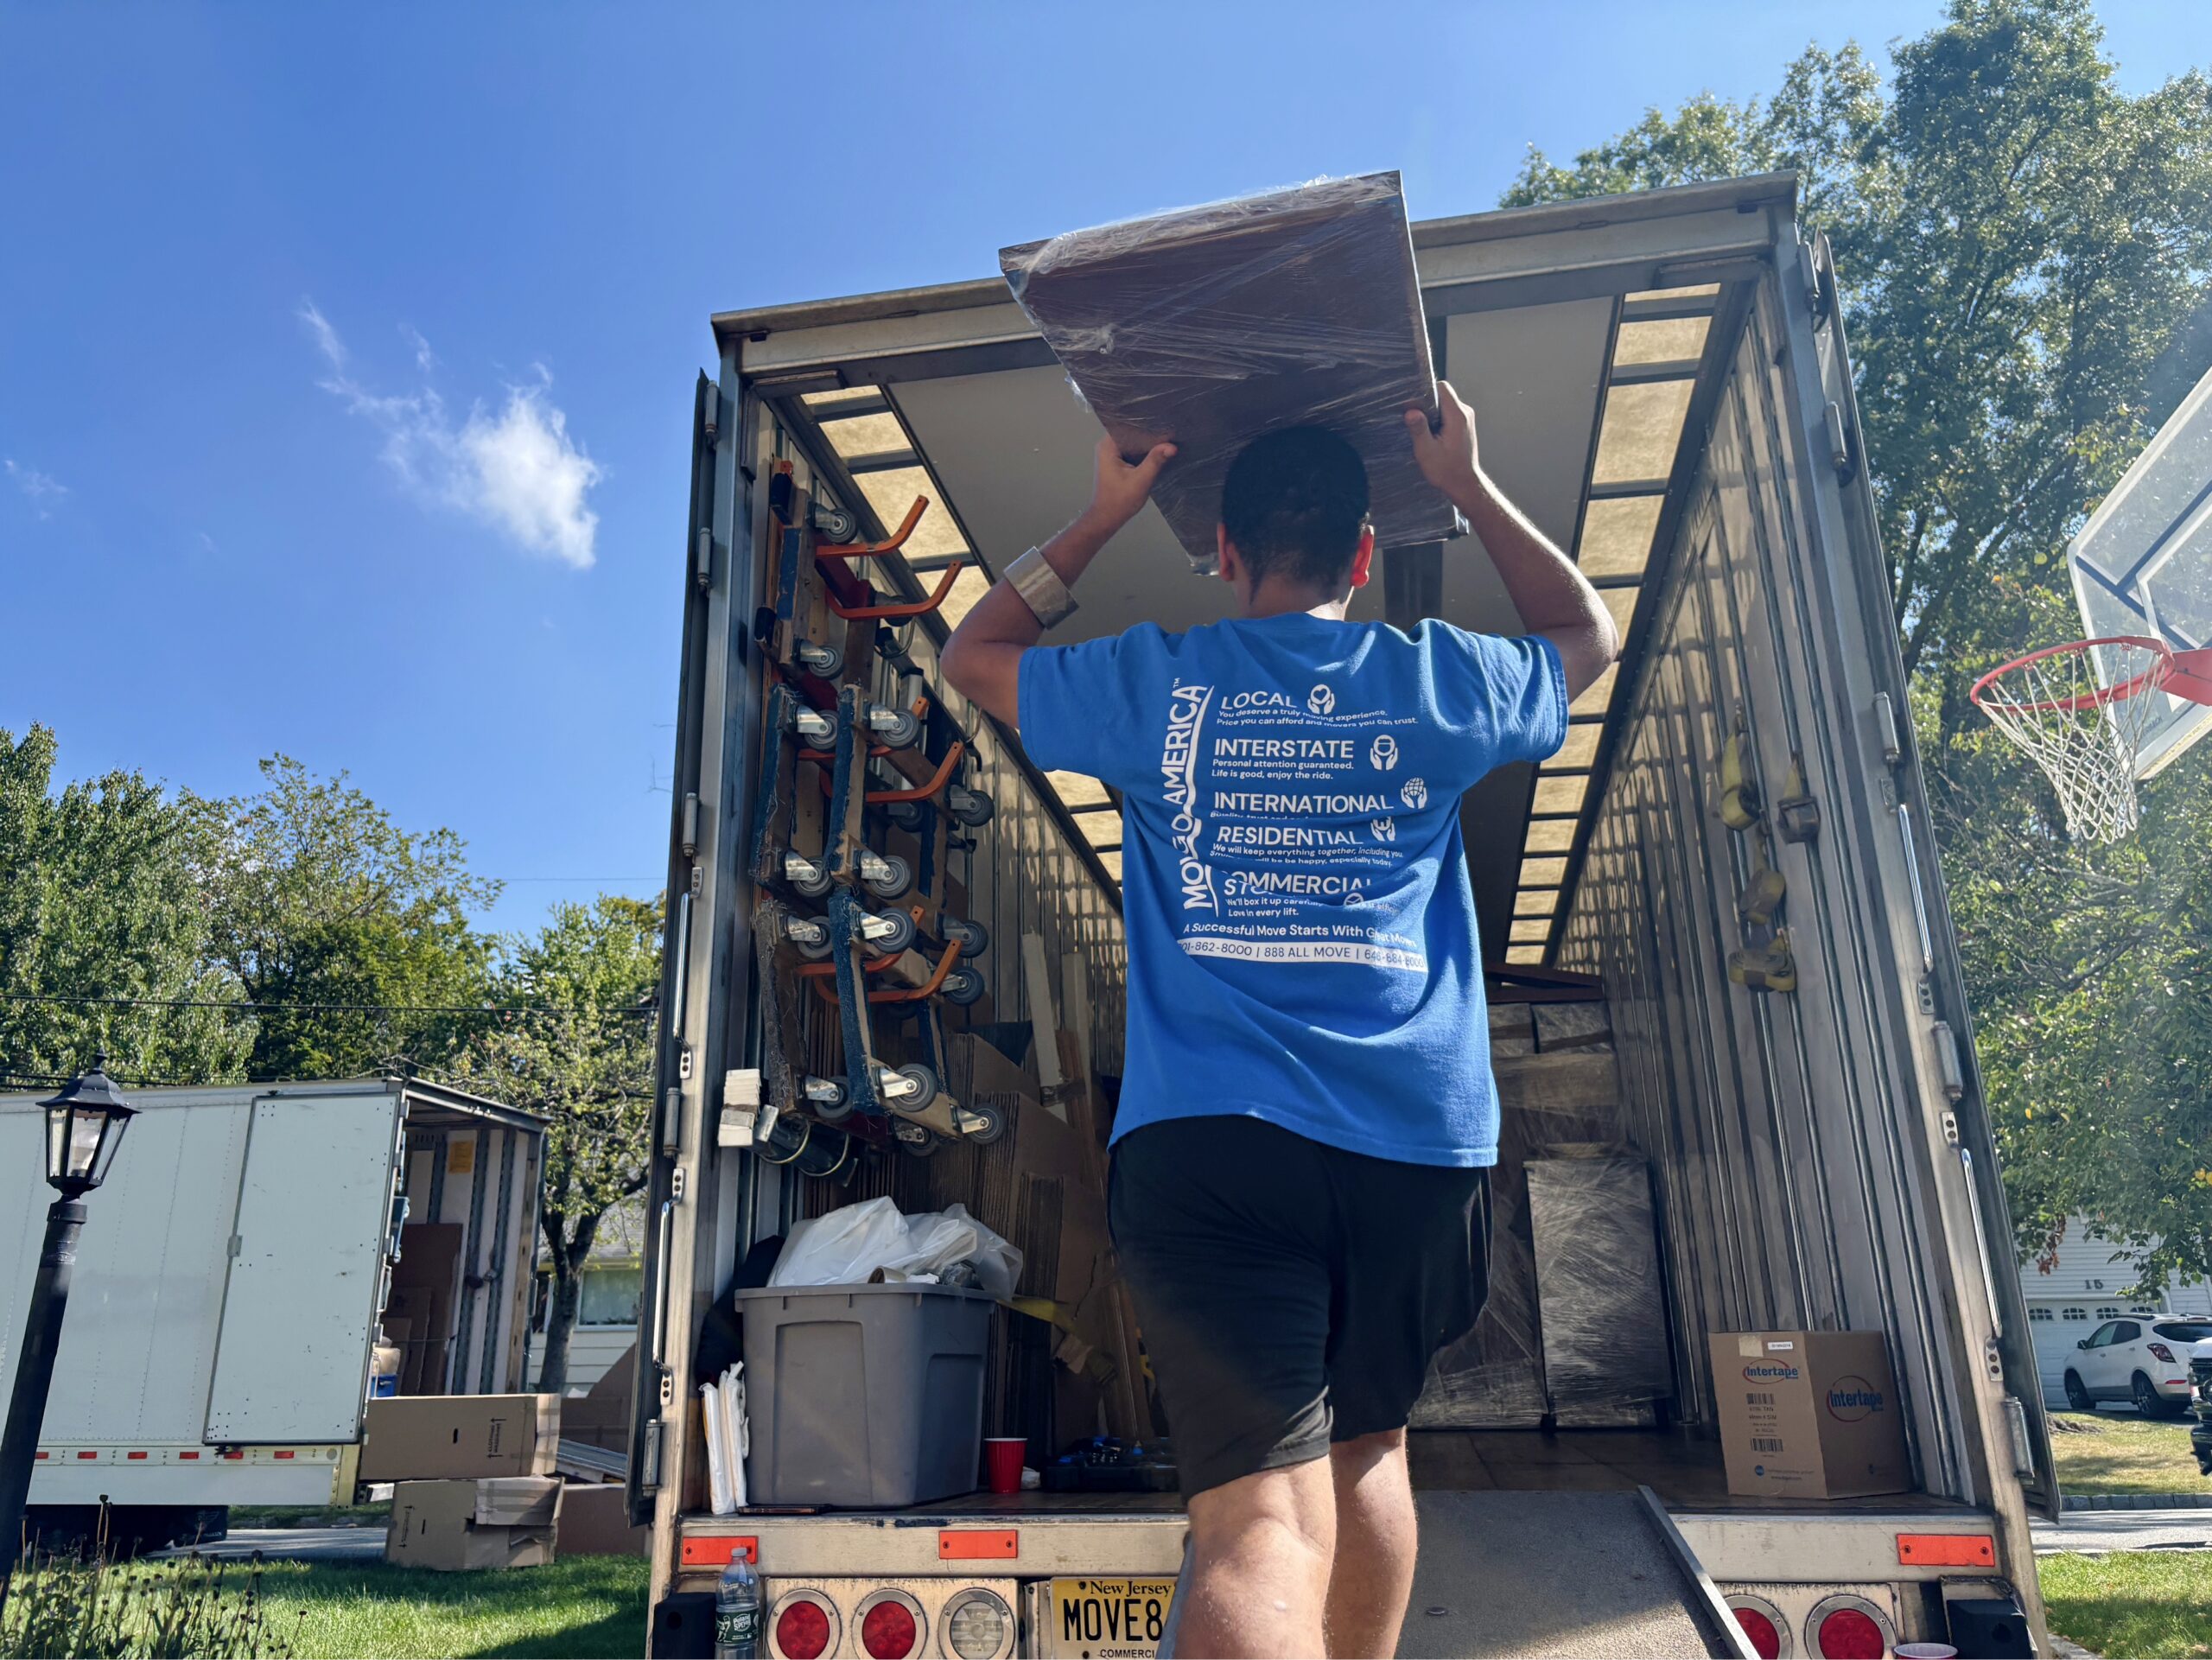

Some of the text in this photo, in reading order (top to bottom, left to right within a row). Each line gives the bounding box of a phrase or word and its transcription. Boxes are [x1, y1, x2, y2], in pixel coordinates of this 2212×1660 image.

[1221, 691, 1297, 709] LOCAL
[1303, 712, 1334, 722] moving
[1336, 710, 1388, 722] experience.
[1161, 685, 1208, 805] AMERICA
[1214, 739, 1354, 759] INTERSTATE
[1212, 759, 1354, 770] Personal attention guaranteed.
[1211, 769, 1228, 778] Life
[1230, 769, 1237, 778] is
[1240, 770, 1264, 779] good,
[1267, 771, 1293, 780] enjoy
[1214, 792, 1394, 813] INTERNATIONAL
[1217, 826, 1363, 846] RESIDENTIAL
[1212, 843, 1226, 852] We
[1228, 846, 1242, 855] will
[1243, 847, 1265, 856] keep
[1267, 848, 1316, 857] everything
[1318, 847, 1356, 856] together,
[1358, 847, 1389, 858] including
[1329, 856, 1370, 865] especially
[1372, 857, 1393, 868] today.
[1244, 898, 1260, 906] box
[1261, 897, 1268, 906] it
[1269, 898, 1281, 906] up
[1255, 909, 1281, 918] every
[1283, 907, 1300, 916] lift.
[1183, 923, 1190, 934] A
[1192, 922, 1255, 936] Successful
[1257, 925, 1287, 936] Move
[1289, 924, 1329, 937] Starts
[1332, 925, 1363, 937] With
[1180, 941, 1252, 957] 01-862-8000
[1264, 947, 1285, 957] 888
[1287, 947, 1309, 957] ALL
[1314, 946, 1351, 957] MOVE
[2085, 1279, 2103, 1289] 15
[1090, 1580, 1172, 1597] New Jersey
